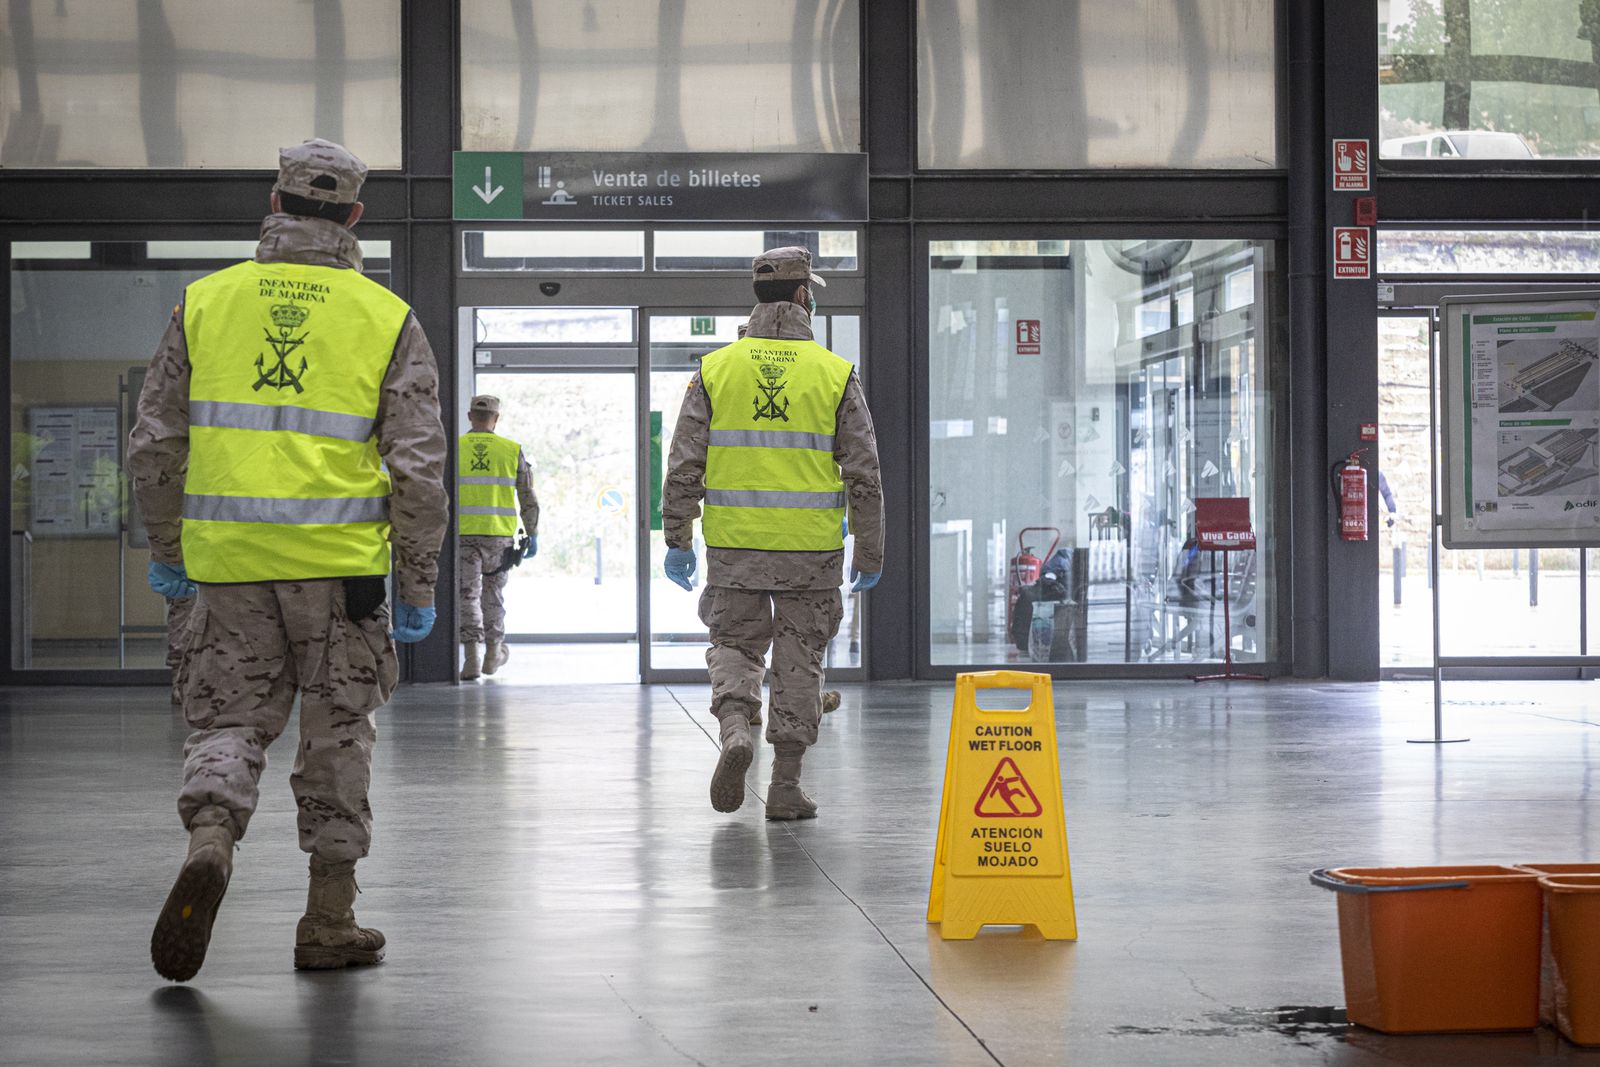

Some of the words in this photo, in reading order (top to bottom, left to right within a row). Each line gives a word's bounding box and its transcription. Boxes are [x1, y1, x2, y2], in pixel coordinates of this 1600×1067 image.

[592, 169, 648, 187] Venta
[656, 169, 681, 187] de
[688, 169, 761, 187] billetes
[592, 195, 633, 206] TICKET
[638, 195, 673, 206] SALES
[1338, 266, 1366, 274] EXTINTOR
[259, 278, 330, 294] INFANTERIA
[259, 288, 275, 297] DE
[278, 289, 326, 303] MARINA
[1575, 499, 1598, 508] adif
[1201, 531, 1224, 540] Viva
[975, 726, 1033, 736] CAUTION
[969, 740, 996, 751] WET
[999, 740, 1042, 751] FLOOR
[984, 841, 1032, 852] SUELO
[978, 855, 1039, 867] MOJADO
